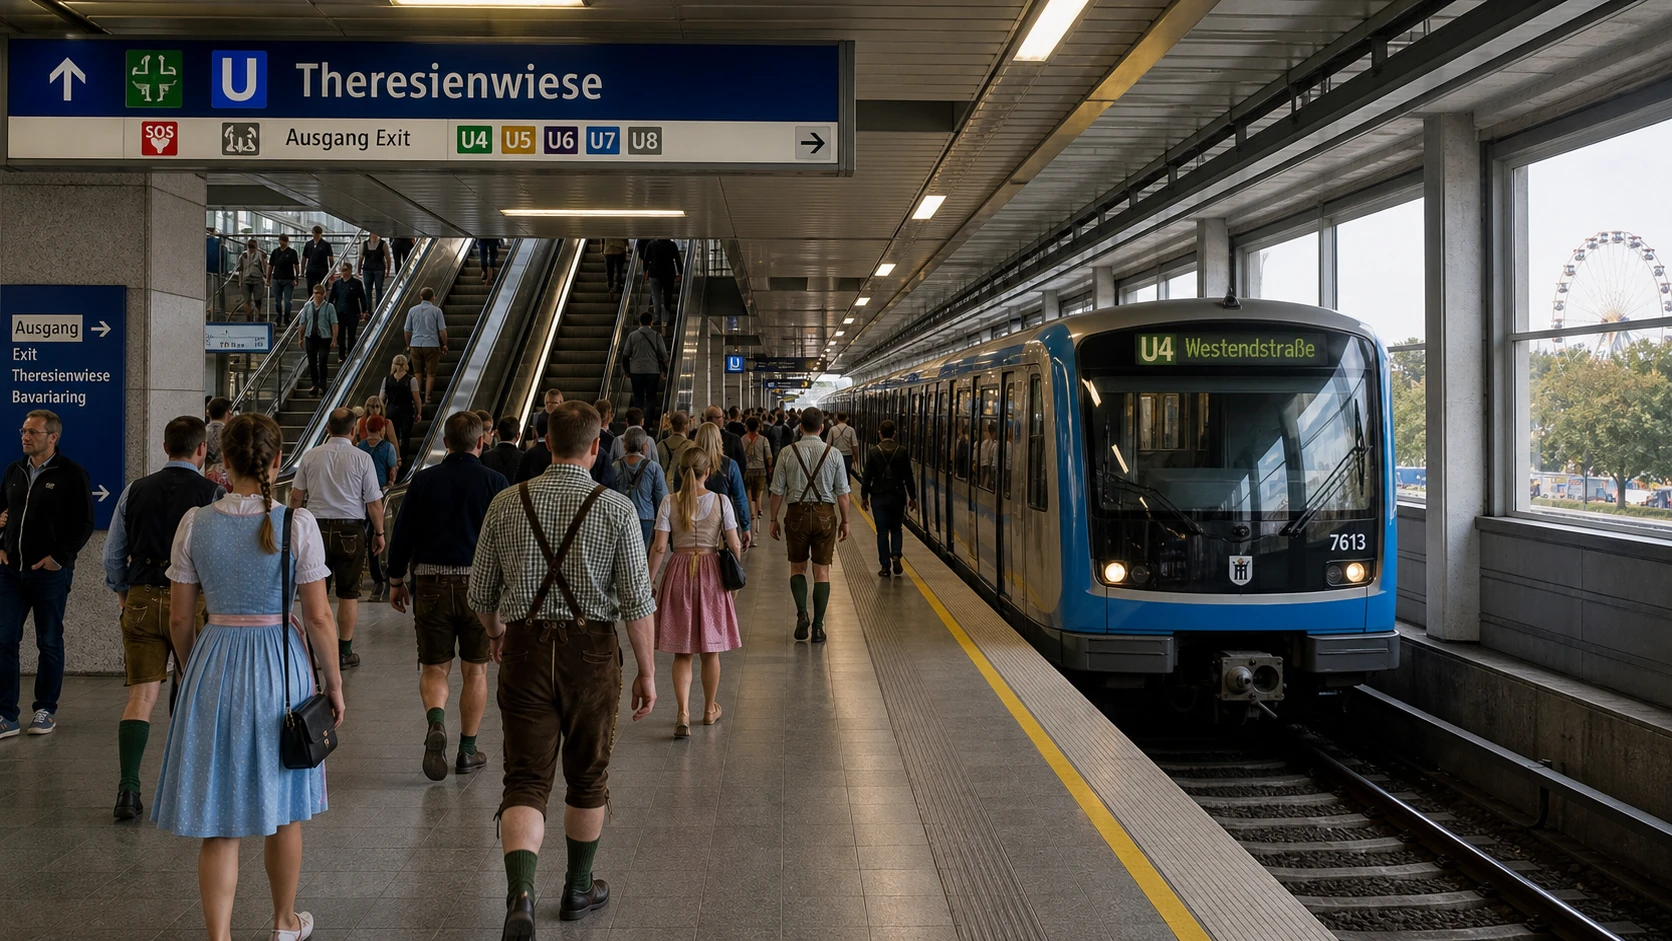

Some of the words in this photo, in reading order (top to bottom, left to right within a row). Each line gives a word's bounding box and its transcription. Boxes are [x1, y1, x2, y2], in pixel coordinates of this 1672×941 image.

[221, 57, 257, 102] U
[295, 61, 603, 100] Theresienwiese
[145, 125, 175, 139] SOS
[285, 128, 369, 151] Ausgang
[376, 128, 411, 147] Exit
[461, 130, 488, 149] U4
[505, 130, 531, 149] U5
[548, 131, 575, 150] U6
[590, 131, 616, 150] U7
[632, 131, 658, 150] U8
[15, 320, 78, 338] Ausgang
[12, 347, 38, 361] Exit
[1140, 336, 1174, 362] U4
[1185, 337, 1316, 358] Westendstraße
[11, 368, 111, 382] Theresienwiese
[11, 389, 87, 407] Bavariaring
[1329, 533, 1366, 551] 7613
